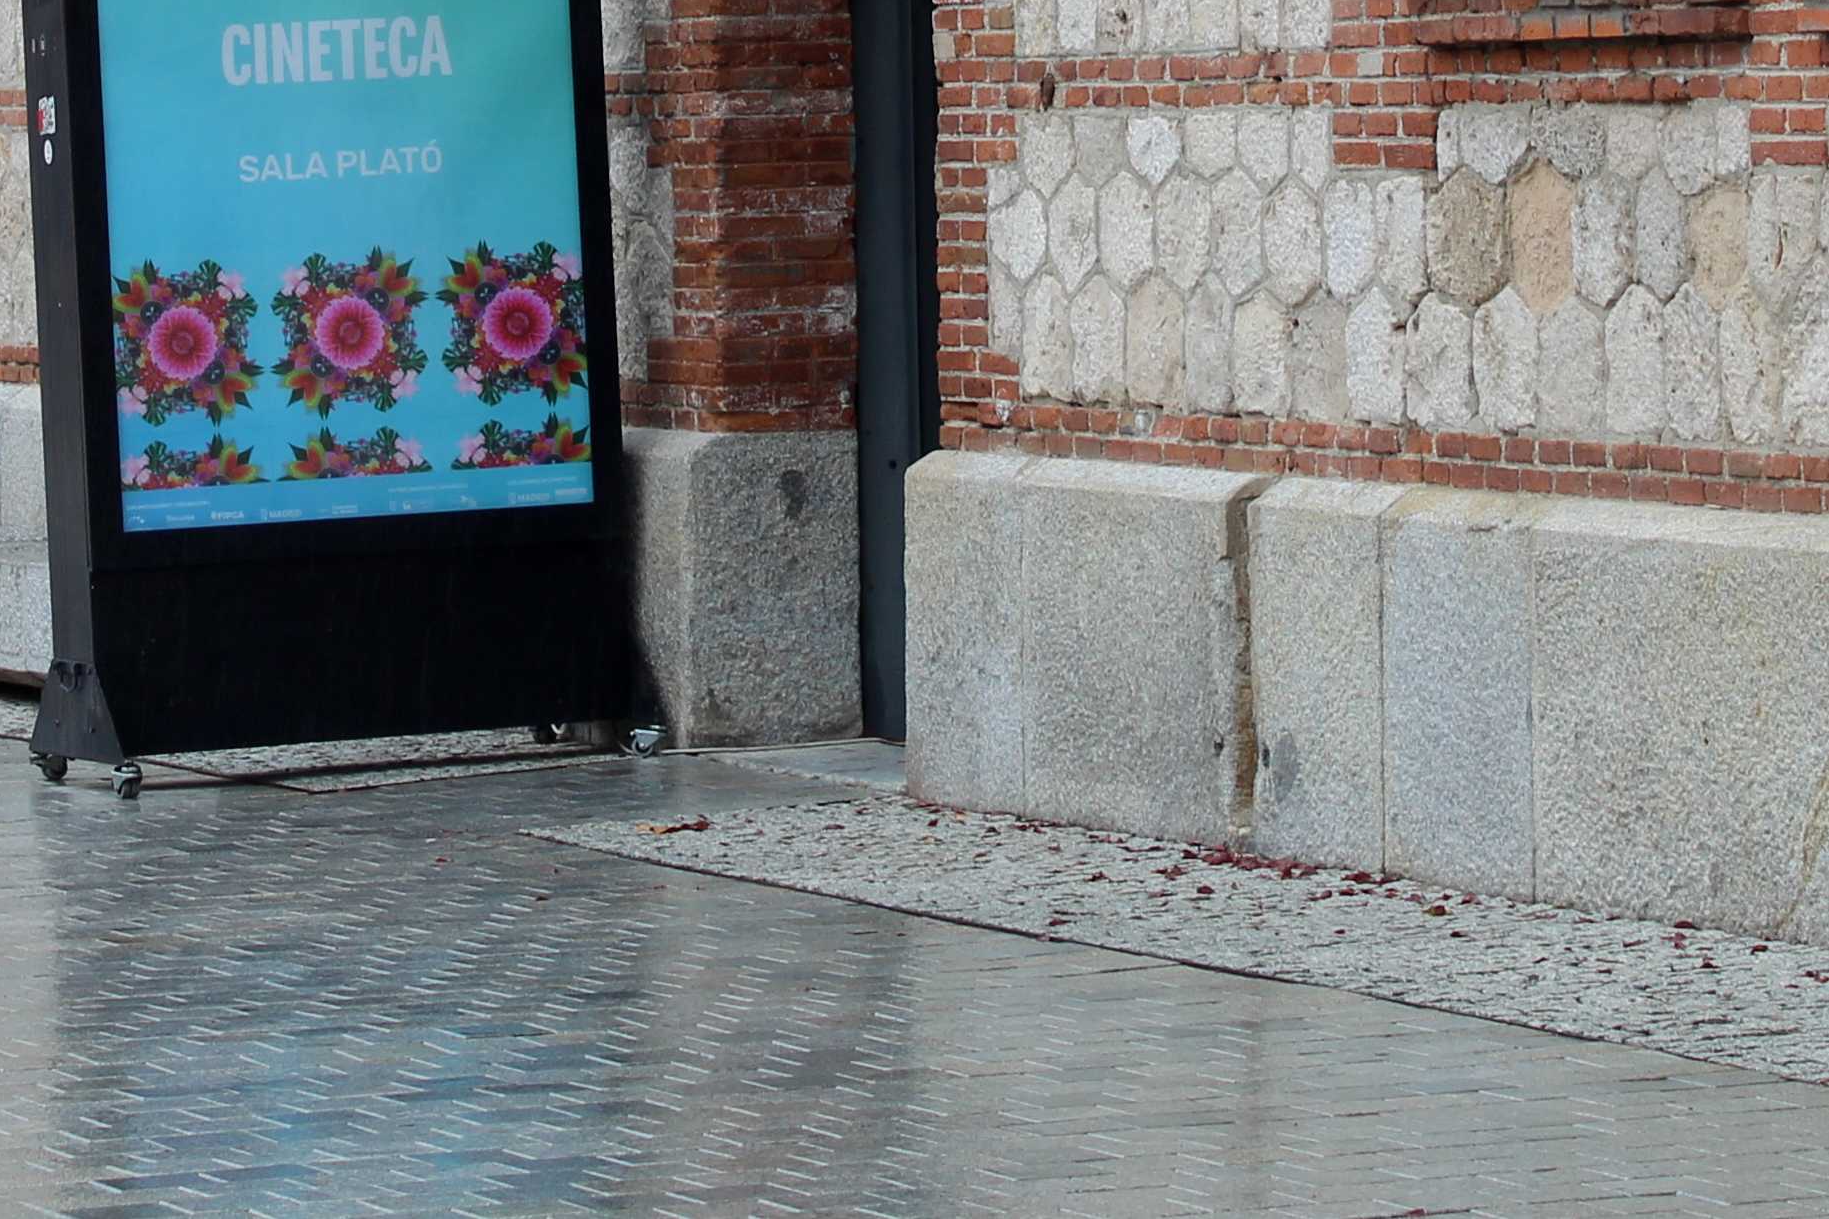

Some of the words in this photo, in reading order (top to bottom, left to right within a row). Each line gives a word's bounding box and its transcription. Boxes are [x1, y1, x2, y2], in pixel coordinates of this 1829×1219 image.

[222, 15, 453, 86] CINETECA
[238, 152, 327, 182] SALA
[337, 139, 442, 177] PLATÓ
